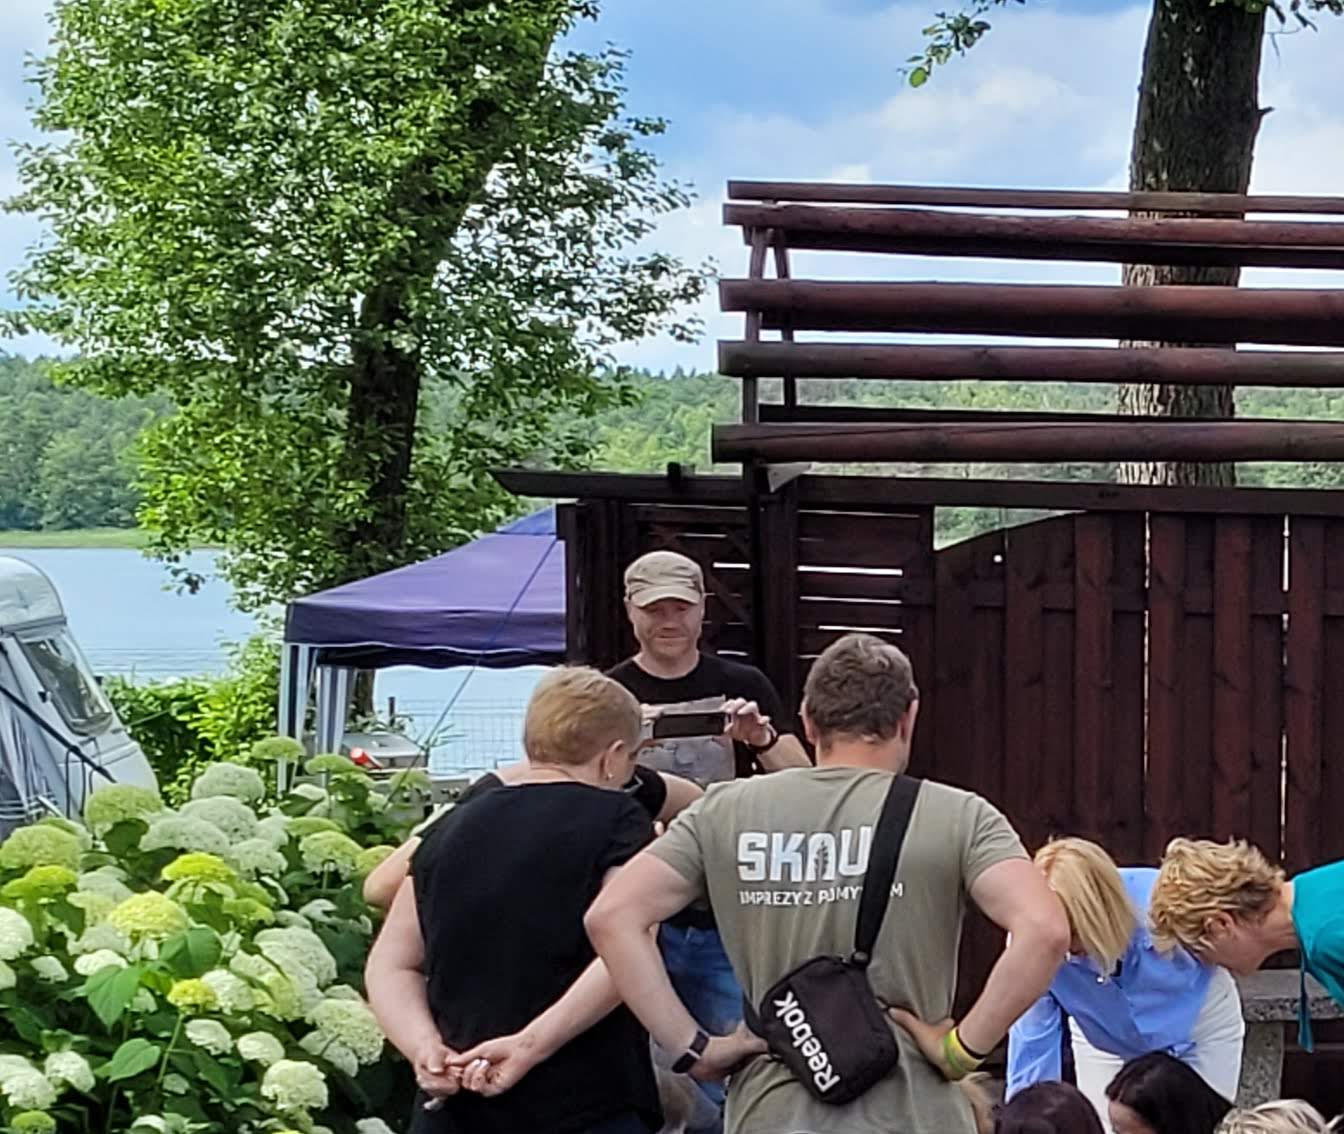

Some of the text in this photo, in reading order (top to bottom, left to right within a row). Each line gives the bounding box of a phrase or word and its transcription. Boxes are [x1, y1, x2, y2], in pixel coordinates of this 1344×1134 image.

[737, 825, 873, 882] SKAU
[803, 890, 814, 905] Z
[773, 991, 841, 1093] Reebok
